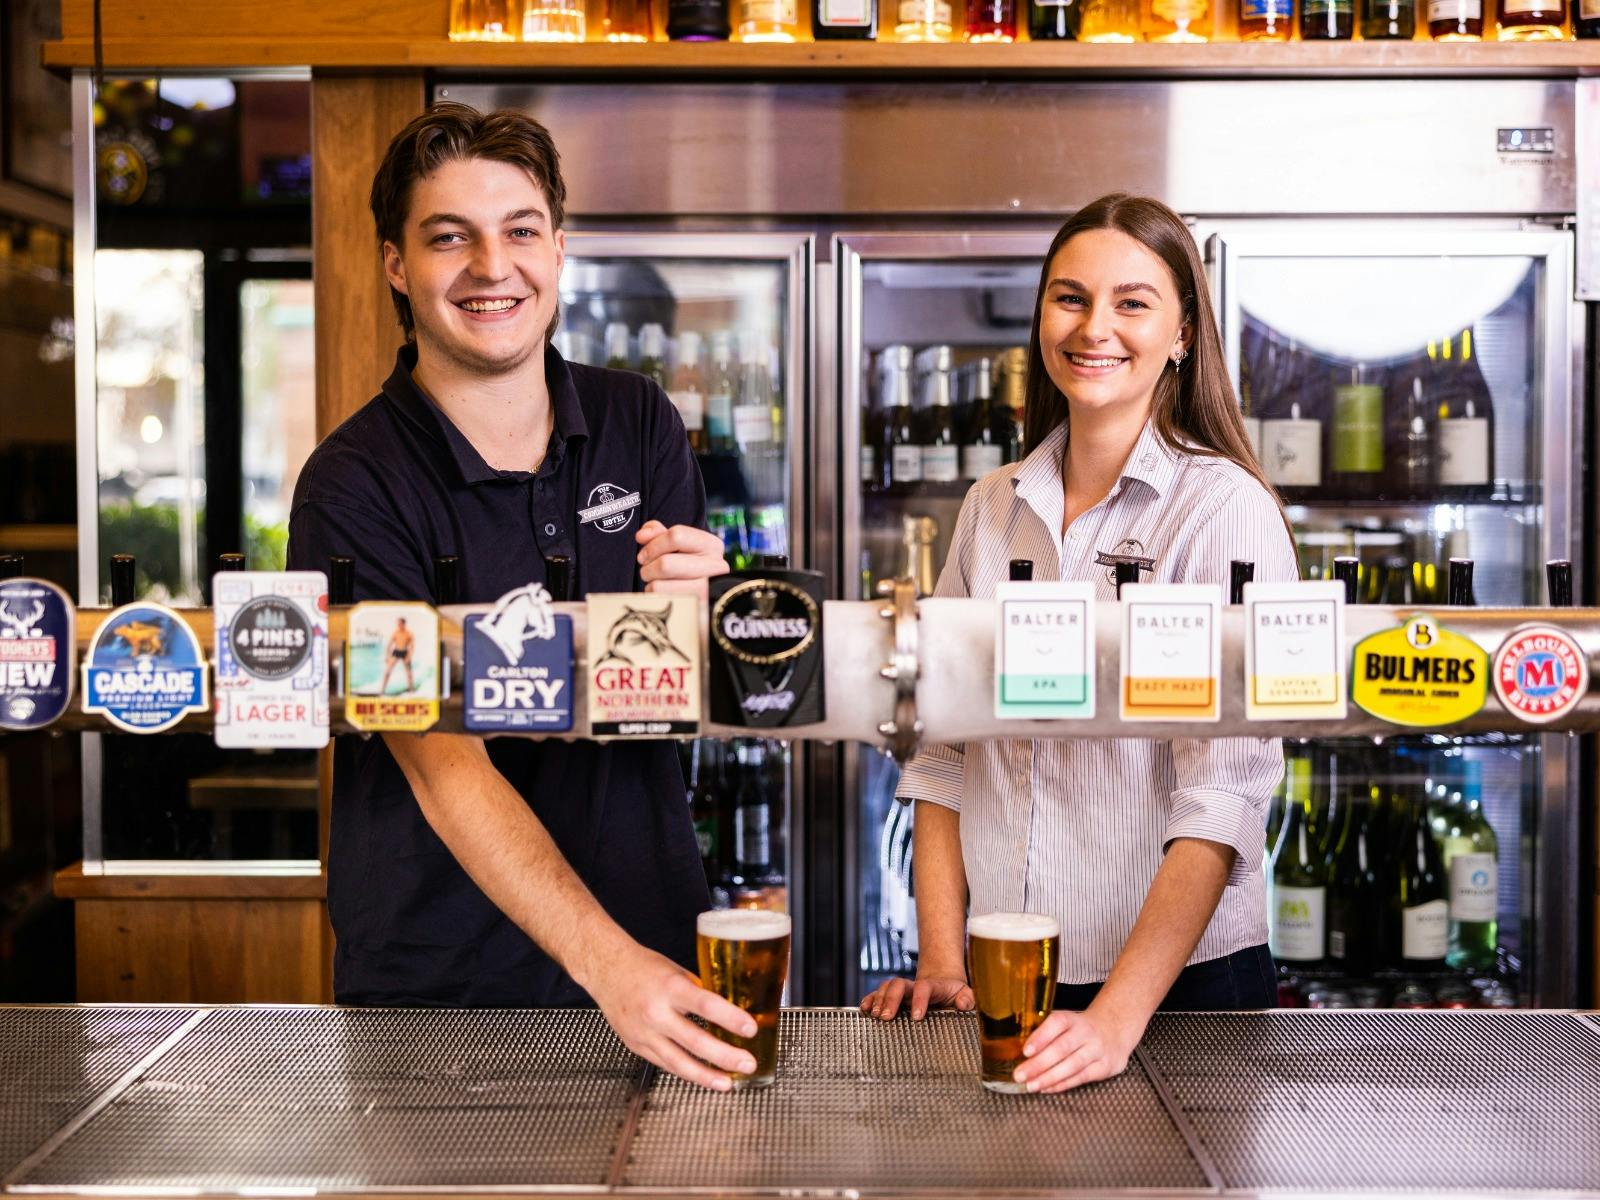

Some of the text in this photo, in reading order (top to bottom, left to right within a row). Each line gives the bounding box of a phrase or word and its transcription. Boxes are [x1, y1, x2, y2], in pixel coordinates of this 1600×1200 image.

[583, 495, 640, 519] COMMONWEALTH
[602, 514, 626, 527] HOTEL
[723, 612, 808, 639] GUINNESS
[1011, 614, 1078, 625] BALTER
[1136, 616, 1205, 628] BALTER
[1261, 613, 1329, 626] BALTER
[237, 629, 305, 647] 4 PINES
[1414, 623, 1432, 646] B
[0, 641, 49, 656] OOHEYS
[1502, 637, 1578, 681] MELBOURNE
[487, 665, 549, 679] CARLTON
[595, 667, 692, 691] GREAT
[1365, 652, 1476, 685] BULMERS
[1523, 658, 1560, 689] M
[95, 671, 196, 694] CASCADE
[473, 679, 565, 709] DRY
[598, 694, 689, 706] NORTHERN
[1508, 685, 1575, 712] BITTER
[236, 703, 307, 722] LAGER
